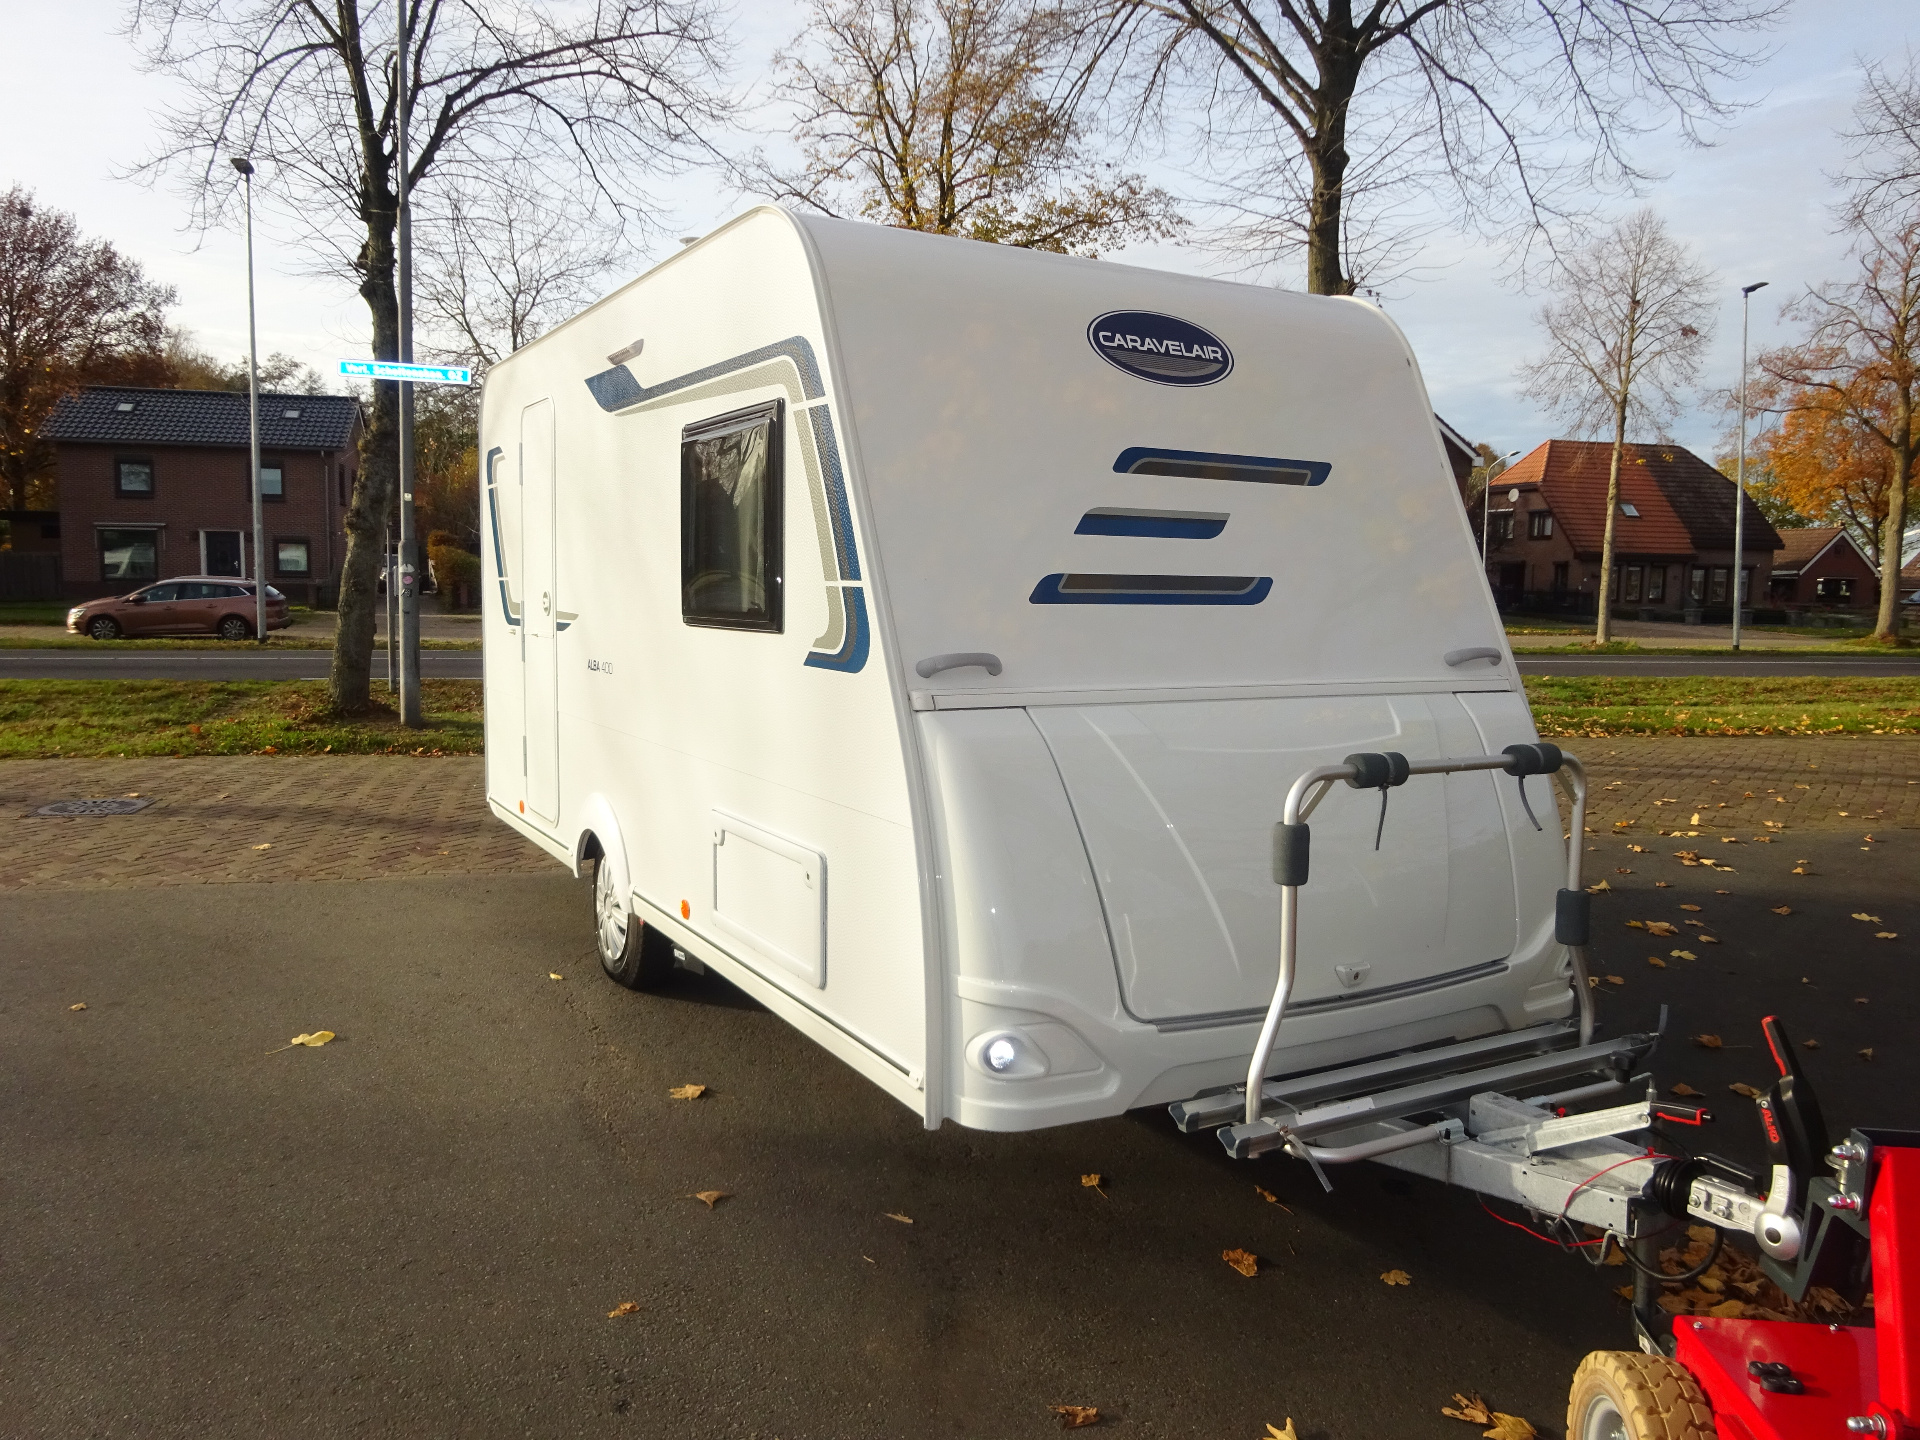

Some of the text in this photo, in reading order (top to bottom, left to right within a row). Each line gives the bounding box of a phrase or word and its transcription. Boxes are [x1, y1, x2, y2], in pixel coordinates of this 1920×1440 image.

[1098, 331, 1224, 361] CARAVELAIR
[587, 658, 614, 675] ALBA 400
